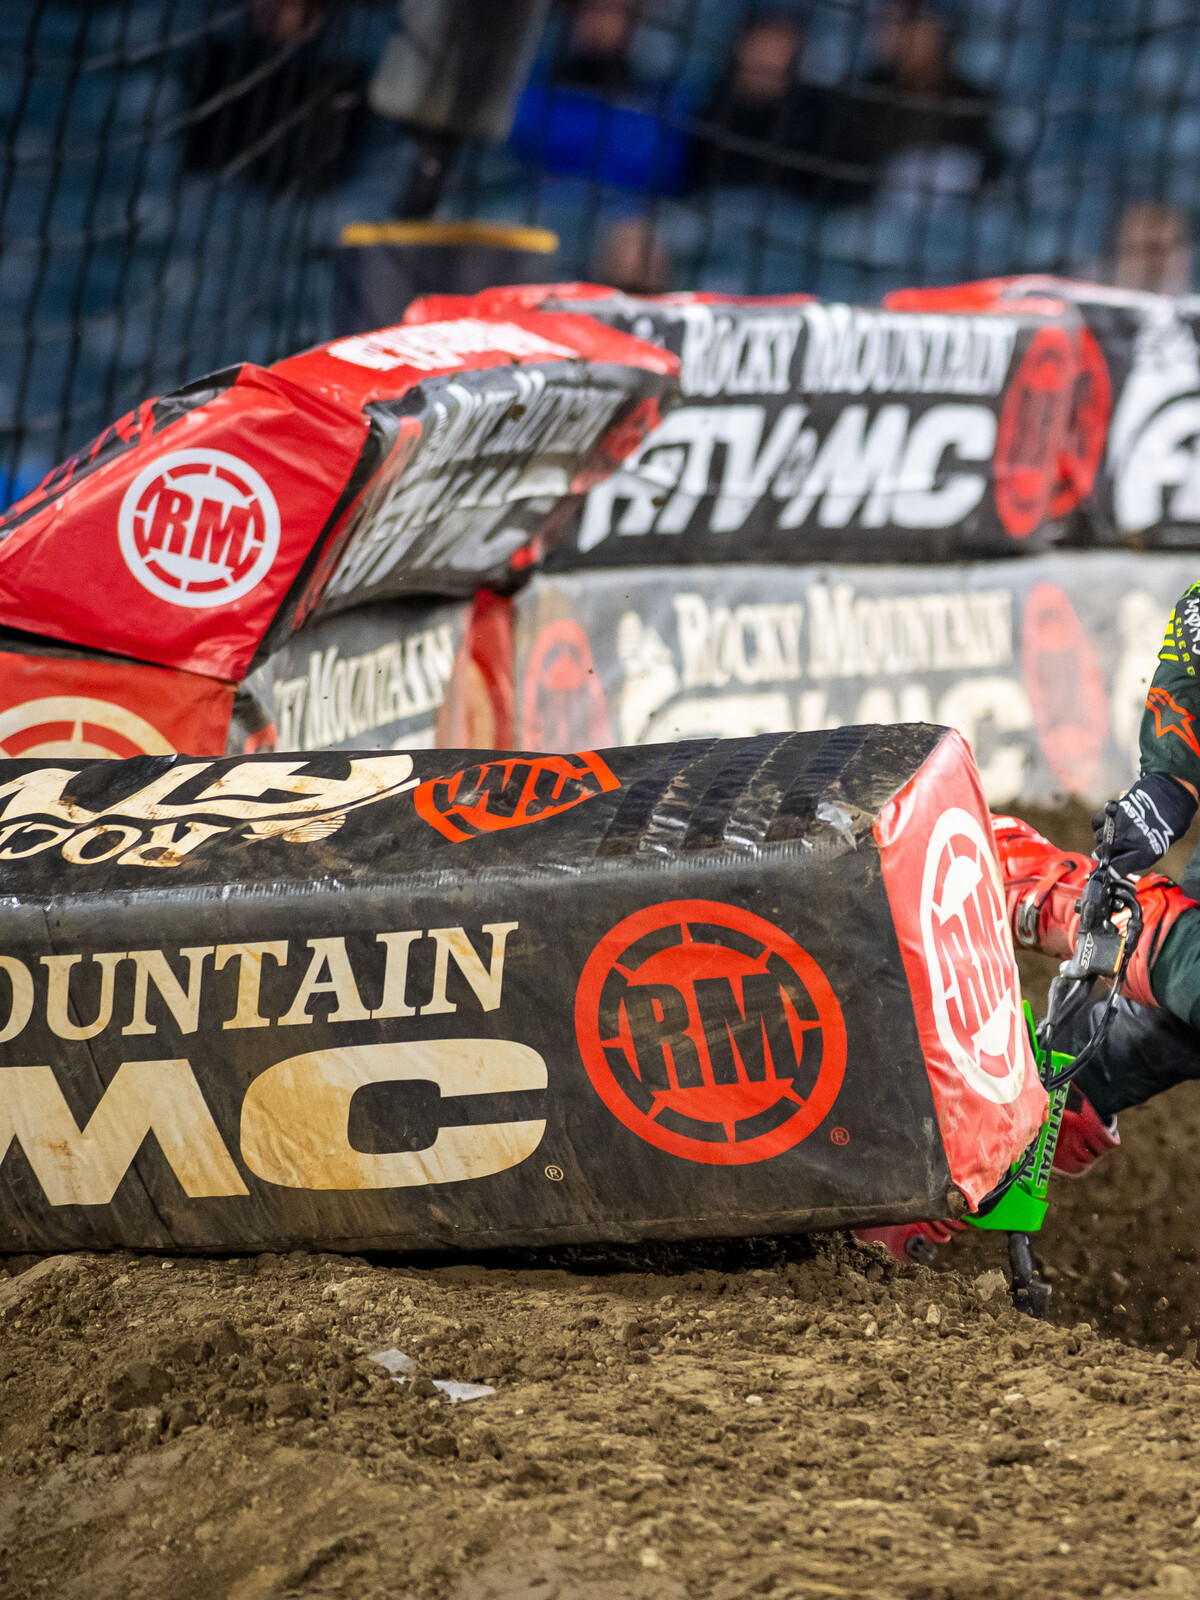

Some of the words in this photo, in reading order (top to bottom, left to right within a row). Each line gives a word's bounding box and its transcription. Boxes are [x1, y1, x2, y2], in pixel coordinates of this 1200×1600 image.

[147, 483, 262, 573] RM
[1119, 800, 1163, 855] ASTARS
[932, 880, 1018, 1028] RM
[622, 972, 803, 1092] RM
